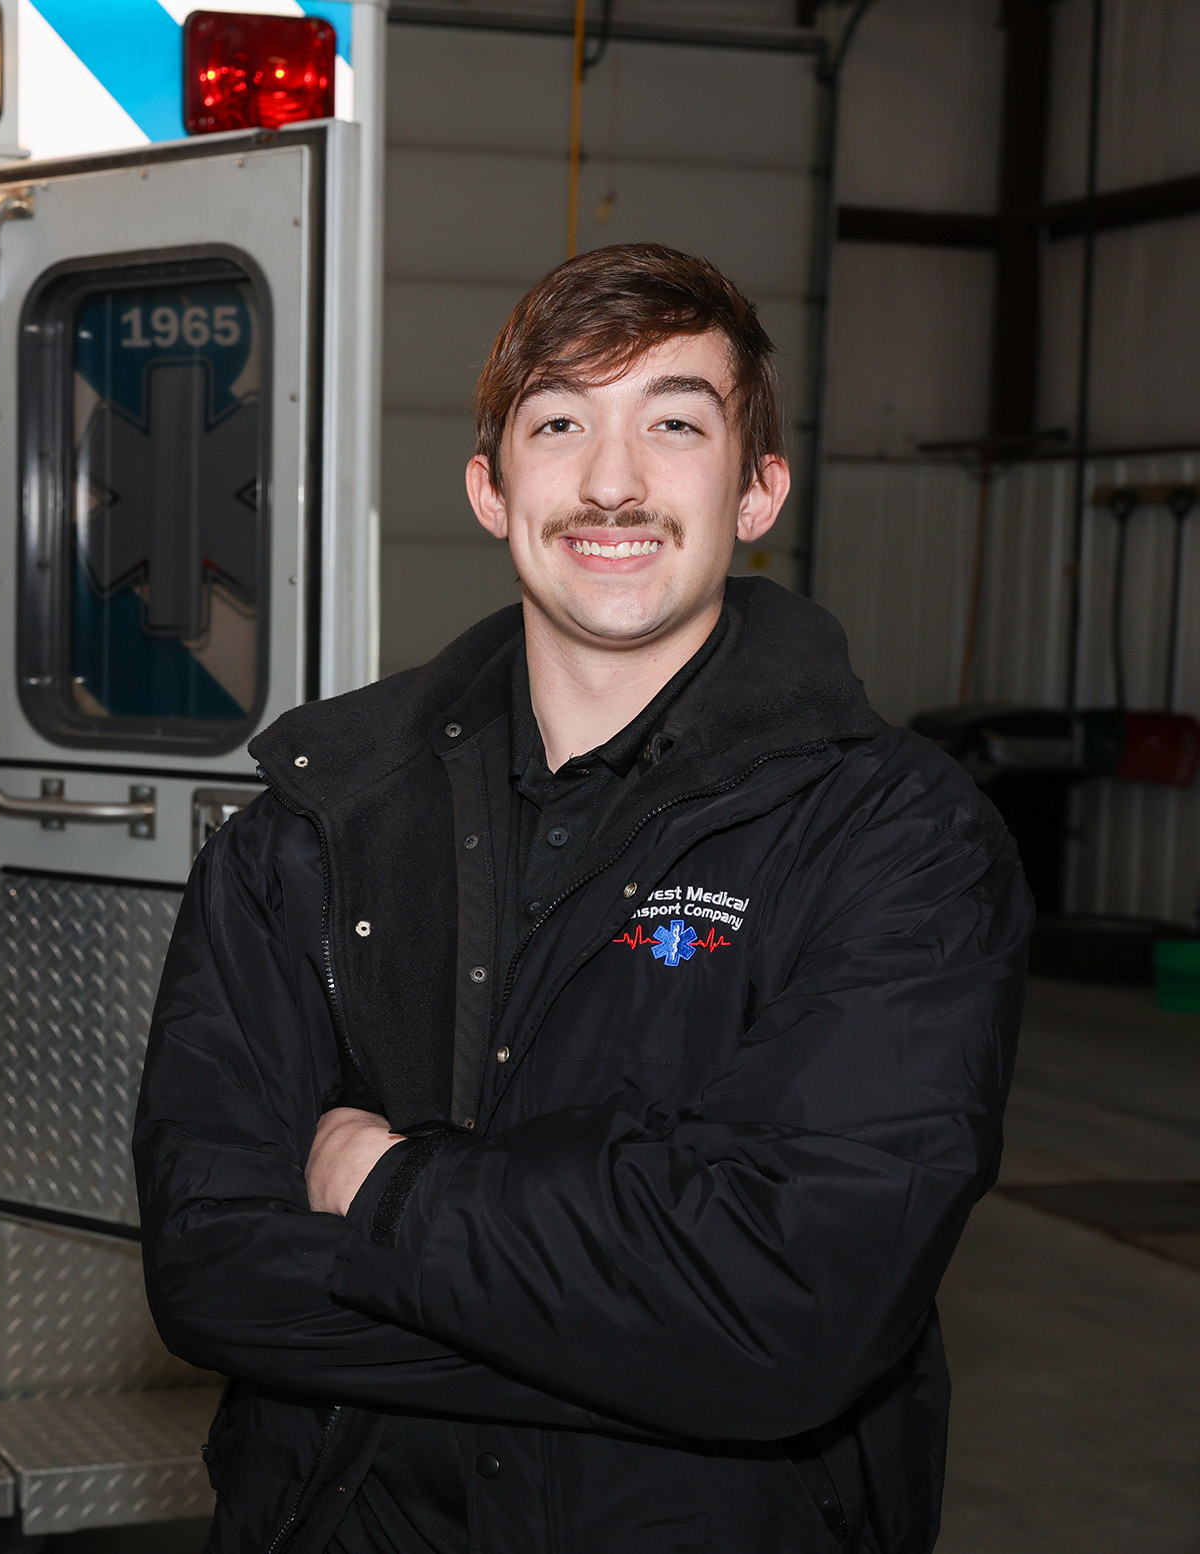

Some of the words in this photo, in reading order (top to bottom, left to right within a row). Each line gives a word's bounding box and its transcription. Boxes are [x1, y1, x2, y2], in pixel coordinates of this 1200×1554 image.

[120, 306, 240, 348] 1965
[686, 886, 750, 912] Medical
[631, 903, 681, 919] nsport
[684, 903, 744, 931] Company
